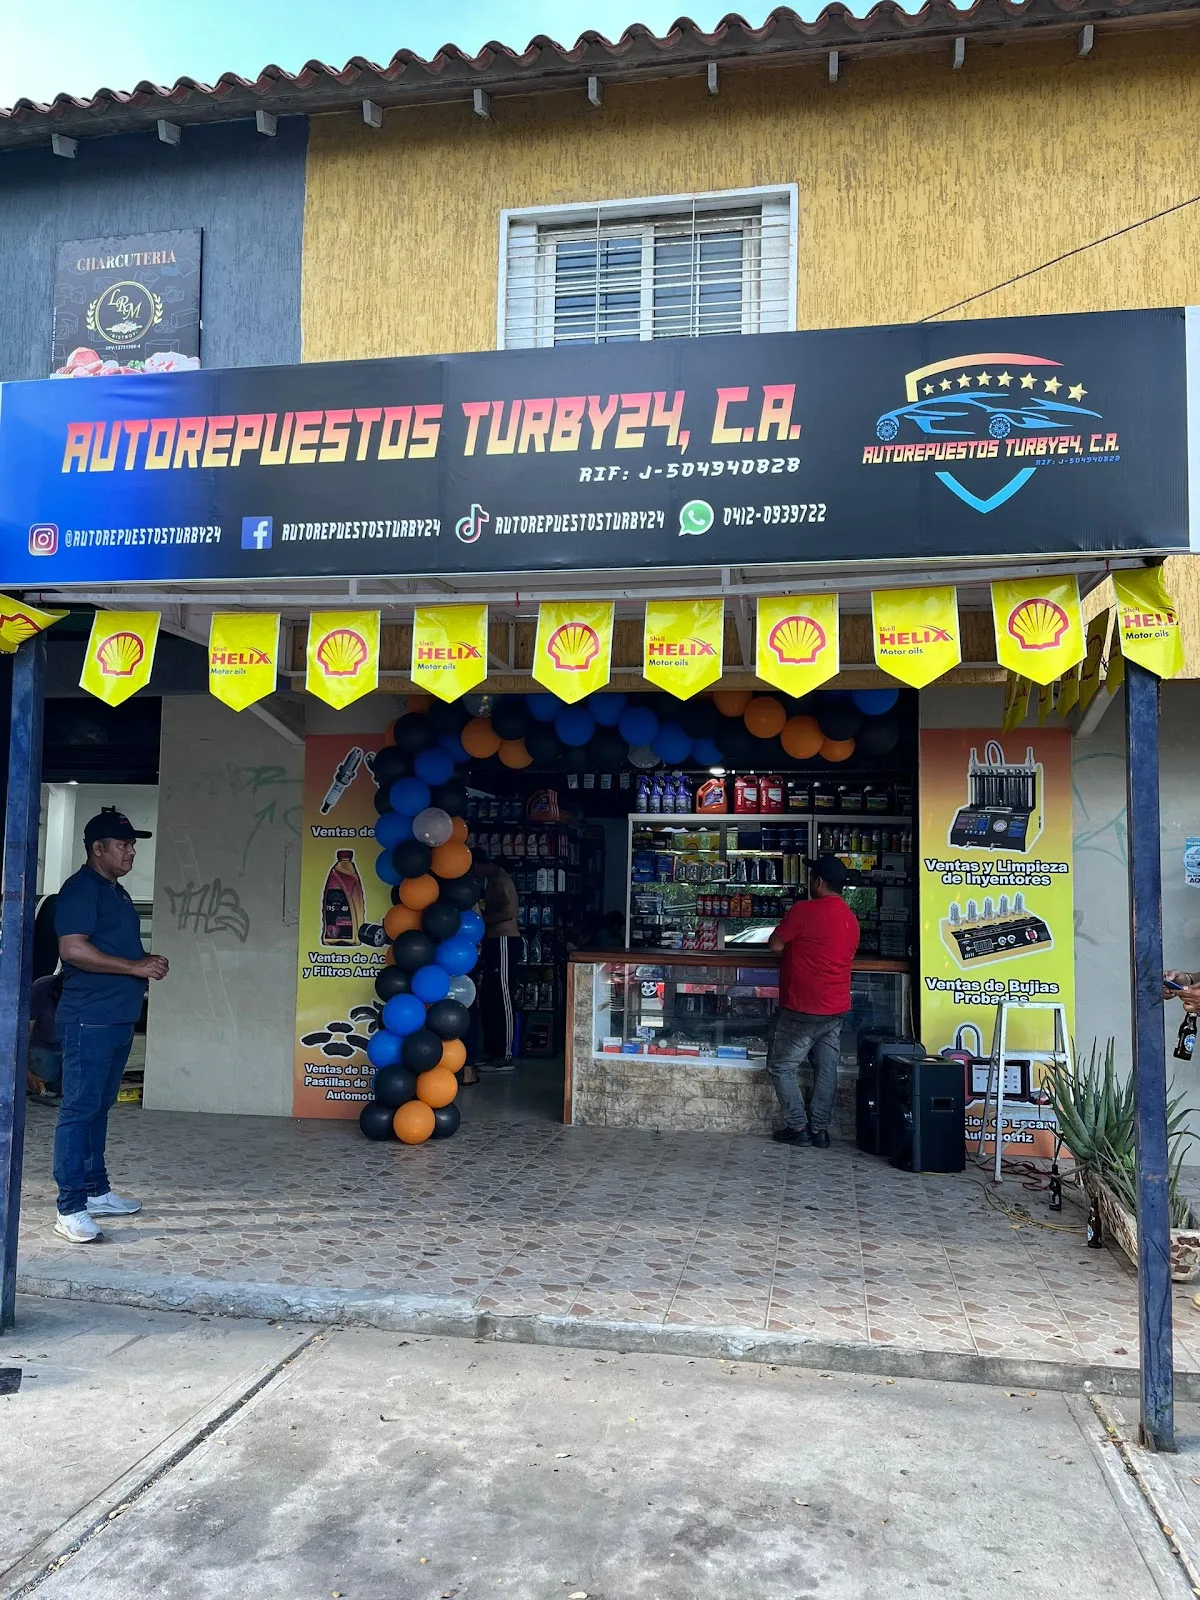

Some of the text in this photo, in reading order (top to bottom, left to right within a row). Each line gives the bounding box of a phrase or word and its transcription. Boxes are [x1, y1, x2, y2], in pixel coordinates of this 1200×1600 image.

[76, 250, 177, 272] CHARCUTERIA
[62, 384, 801, 474] AUTOREPUESTOS TURBY24, C.A.
[862, 432, 1120, 465] AUTOREPUESTOS TURBY24, C.A.
[579, 457, 801, 482] RIF: J-504940828
[723, 504, 827, 526] 0412-0939722
[495, 511, 665, 535] AUTOREPUESTOSTURBY24
[281, 519, 441, 541] AUTOREPUESTOSTURBY24
[64, 526, 222, 548] @AUTOREPUESTOSTURBY24
[879, 629, 952, 645] HELIX
[1125, 630, 1169, 640] Motor oils
[418, 647, 480, 660] HELIX
[649, 643, 715, 656] HELIX
[908, 646, 923, 655] oils
[211, 651, 270, 665] HELIX
[674, 658, 689, 666] oils
[234, 667, 247, 675] oils
[311, 826, 376, 837] Ventas de
[925, 860, 1068, 875] Ventas y Limpieza
[942, 874, 1051, 887] de Inyentores
[309, 952, 350, 963] Ventas
[352, 953, 368, 963] de
[303, 968, 311, 978] y
[313, 967, 351, 976] Filtros
[926, 978, 1059, 995] Ventas de Bujias
[305, 1064, 342, 1074] Ventas
[344, 1066, 359, 1074] de
[304, 1077, 367, 1087] Pastillas de
